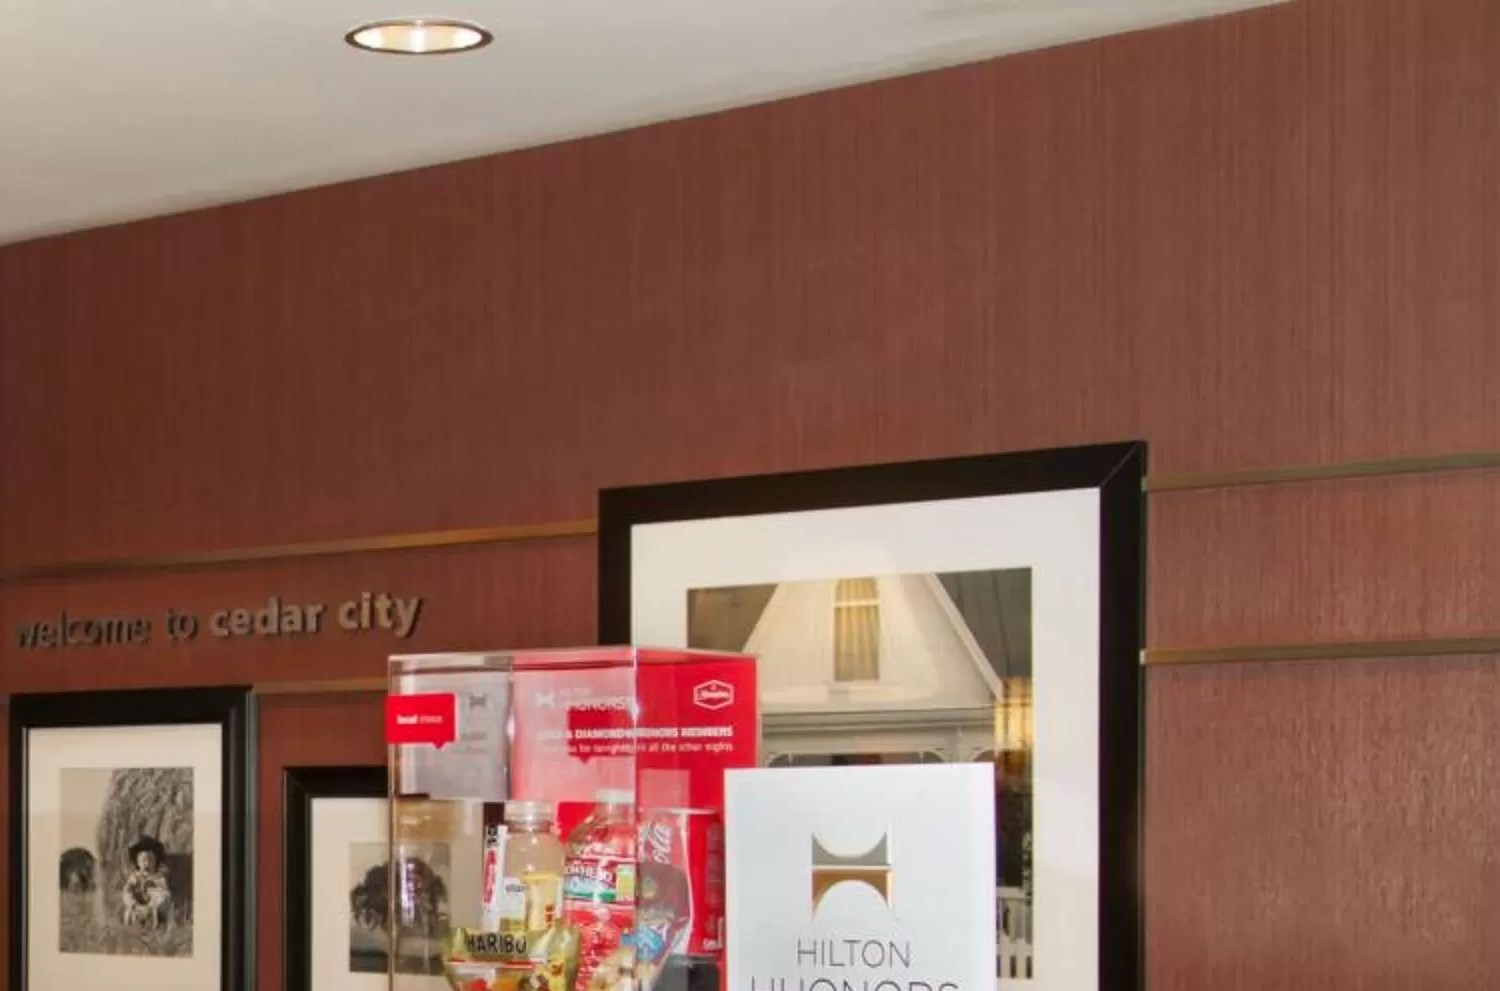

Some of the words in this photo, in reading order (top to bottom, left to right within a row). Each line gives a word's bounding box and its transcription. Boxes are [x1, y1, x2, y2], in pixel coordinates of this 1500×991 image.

[16, 609, 153, 648] welcome
[166, 606, 199, 641] to
[209, 596, 327, 638] cedar
[337, 591, 424, 639] city
[797, 938, 912, 969] HILTON
